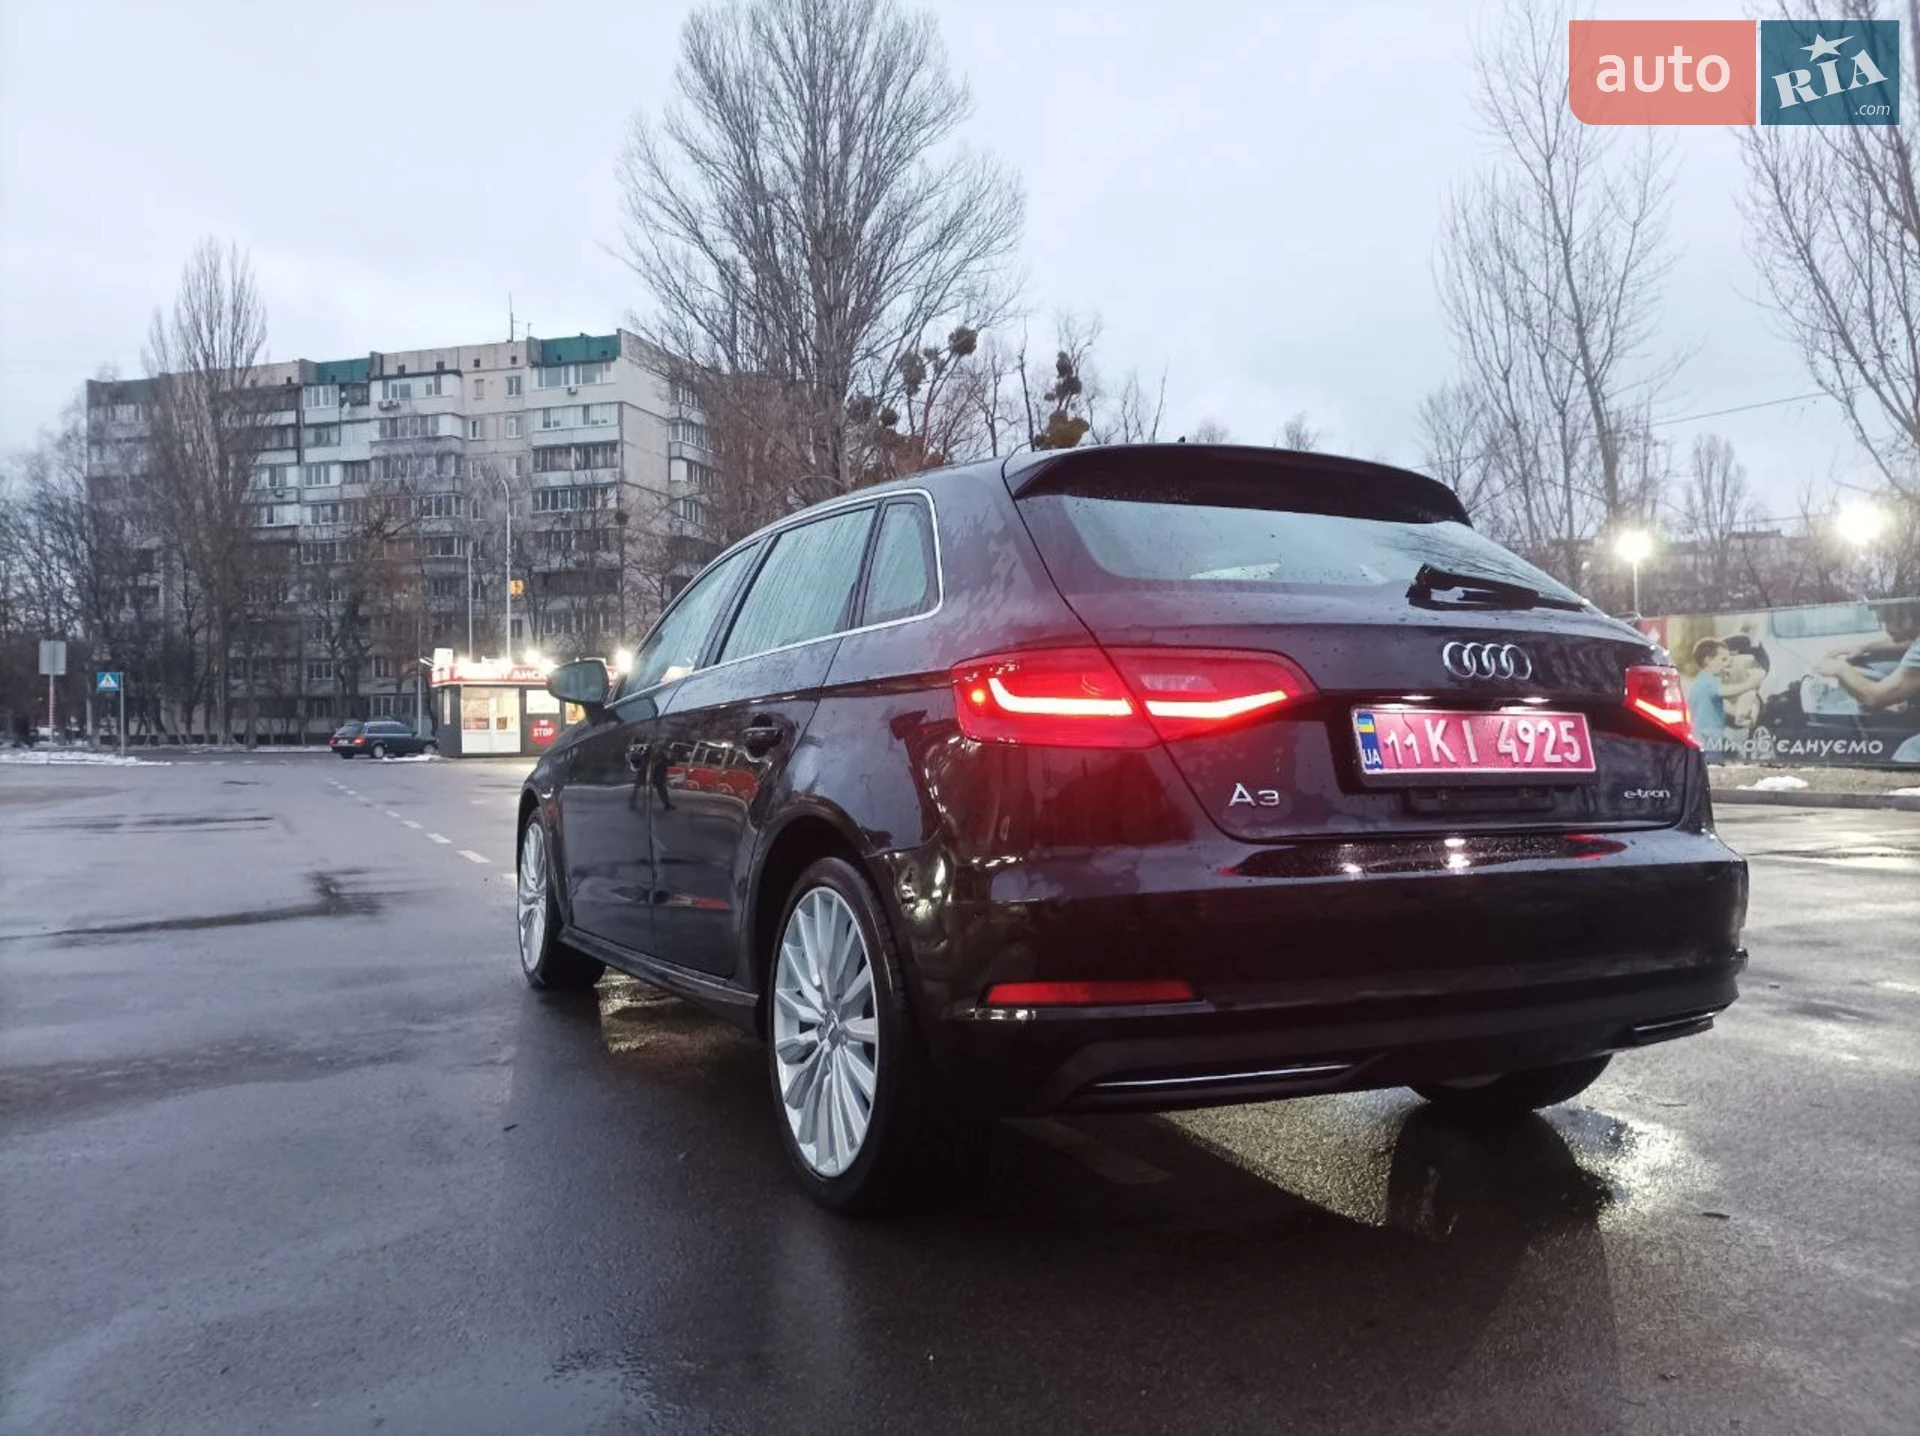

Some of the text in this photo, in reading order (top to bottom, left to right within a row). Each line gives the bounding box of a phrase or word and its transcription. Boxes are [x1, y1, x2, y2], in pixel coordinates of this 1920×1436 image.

[533, 727, 555, 738] STOP
[1384, 729, 1422, 765] 11
[1497, 719, 1583, 763] 4925
[1744, 734, 1884, 758] об'єднуємо
[1361, 749, 1383, 766] UA
[1228, 783, 1280, 807] A3
[1624, 788, 1671, 799] e-tron
